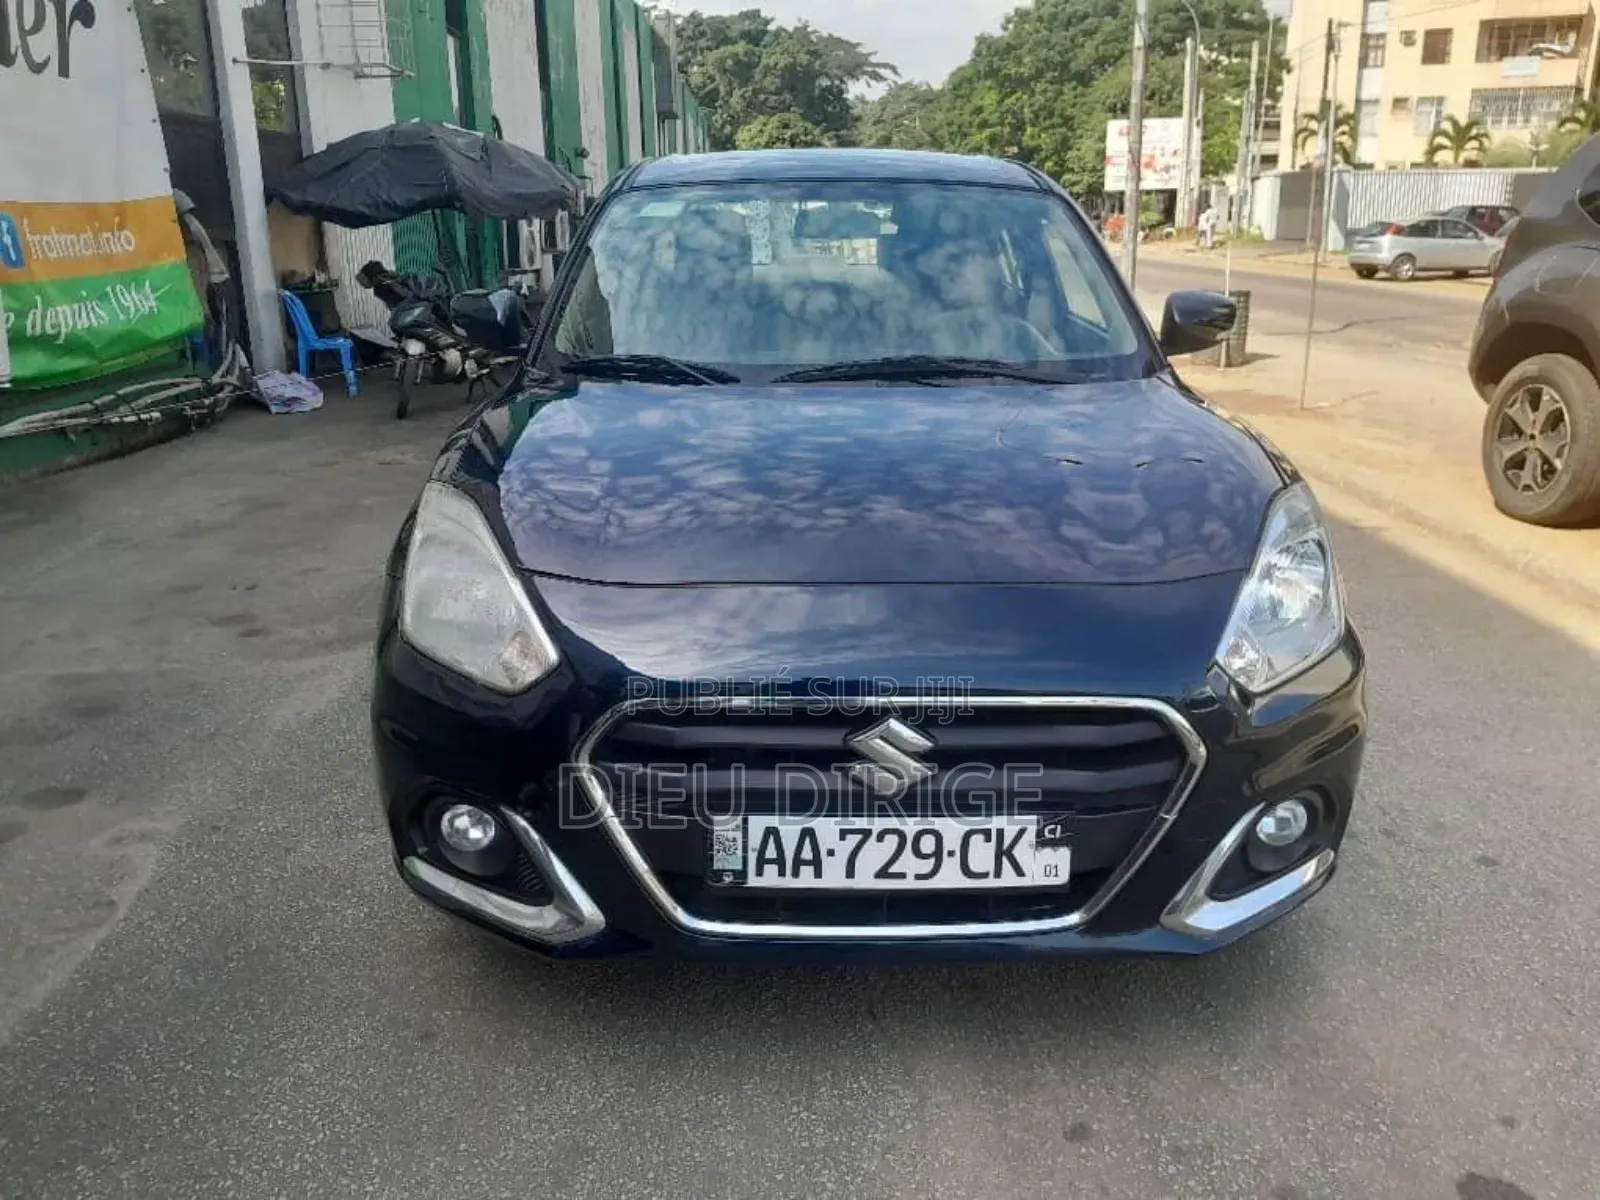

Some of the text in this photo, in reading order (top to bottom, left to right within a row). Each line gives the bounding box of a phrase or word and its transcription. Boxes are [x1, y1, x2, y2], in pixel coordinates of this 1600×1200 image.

[0, 0, 96, 78] er
[26, 289, 109, 344] depuis
[105, 279, 172, 327] 1964
[1044, 864, 1060, 878] 01
